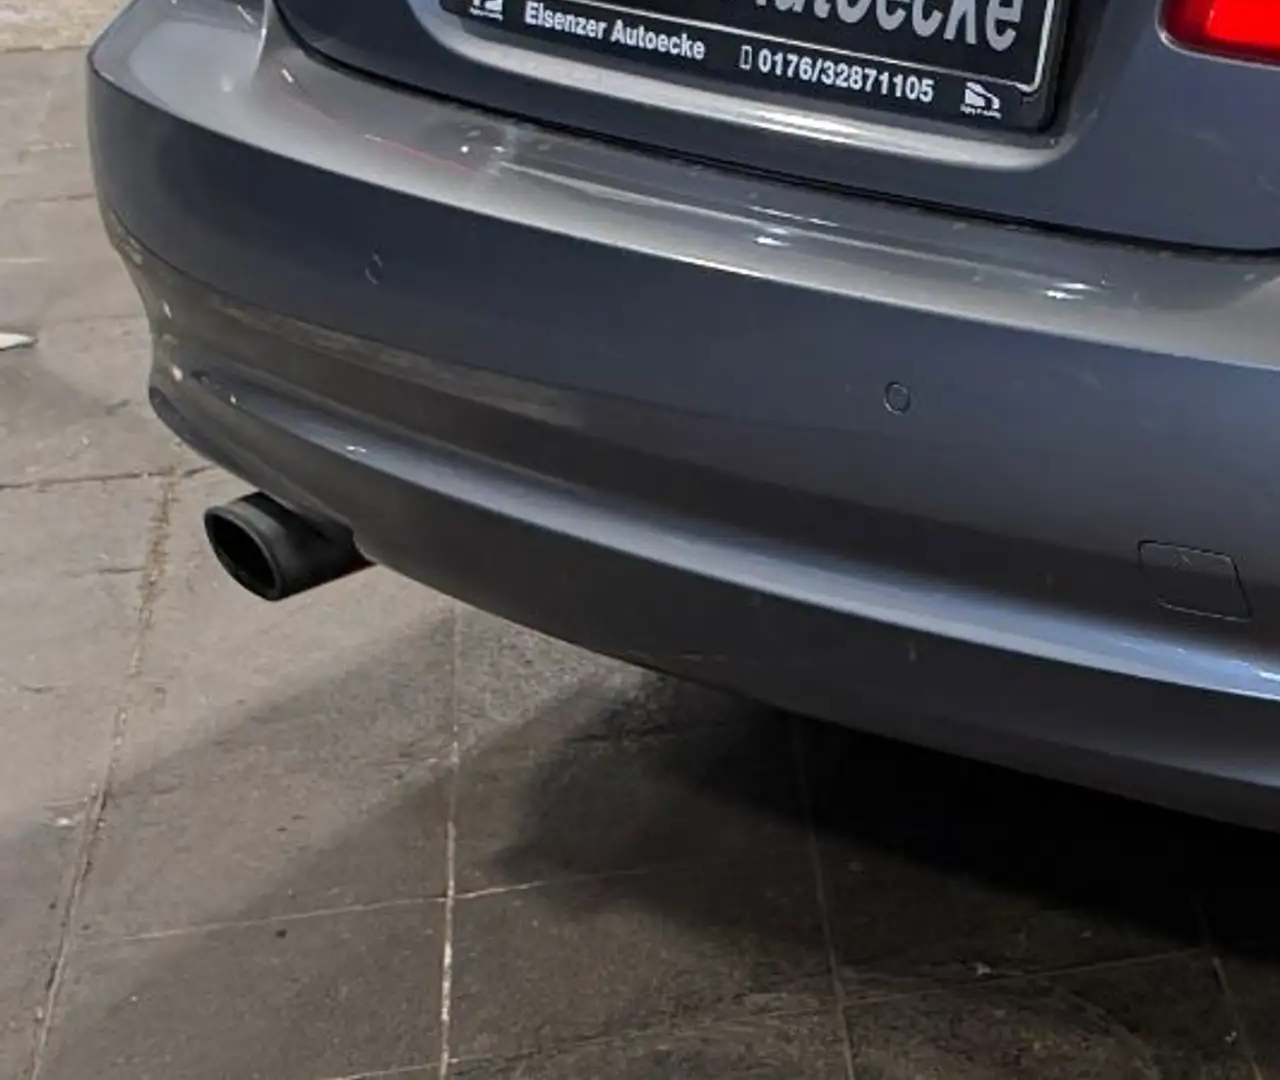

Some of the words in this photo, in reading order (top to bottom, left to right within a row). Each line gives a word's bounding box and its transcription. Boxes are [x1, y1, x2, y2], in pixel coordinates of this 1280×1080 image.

[524, 0, 607, 39] Elsenzer
[610, 19, 706, 60] Autoecke
[757, 48, 935, 103] 0176/32871105
